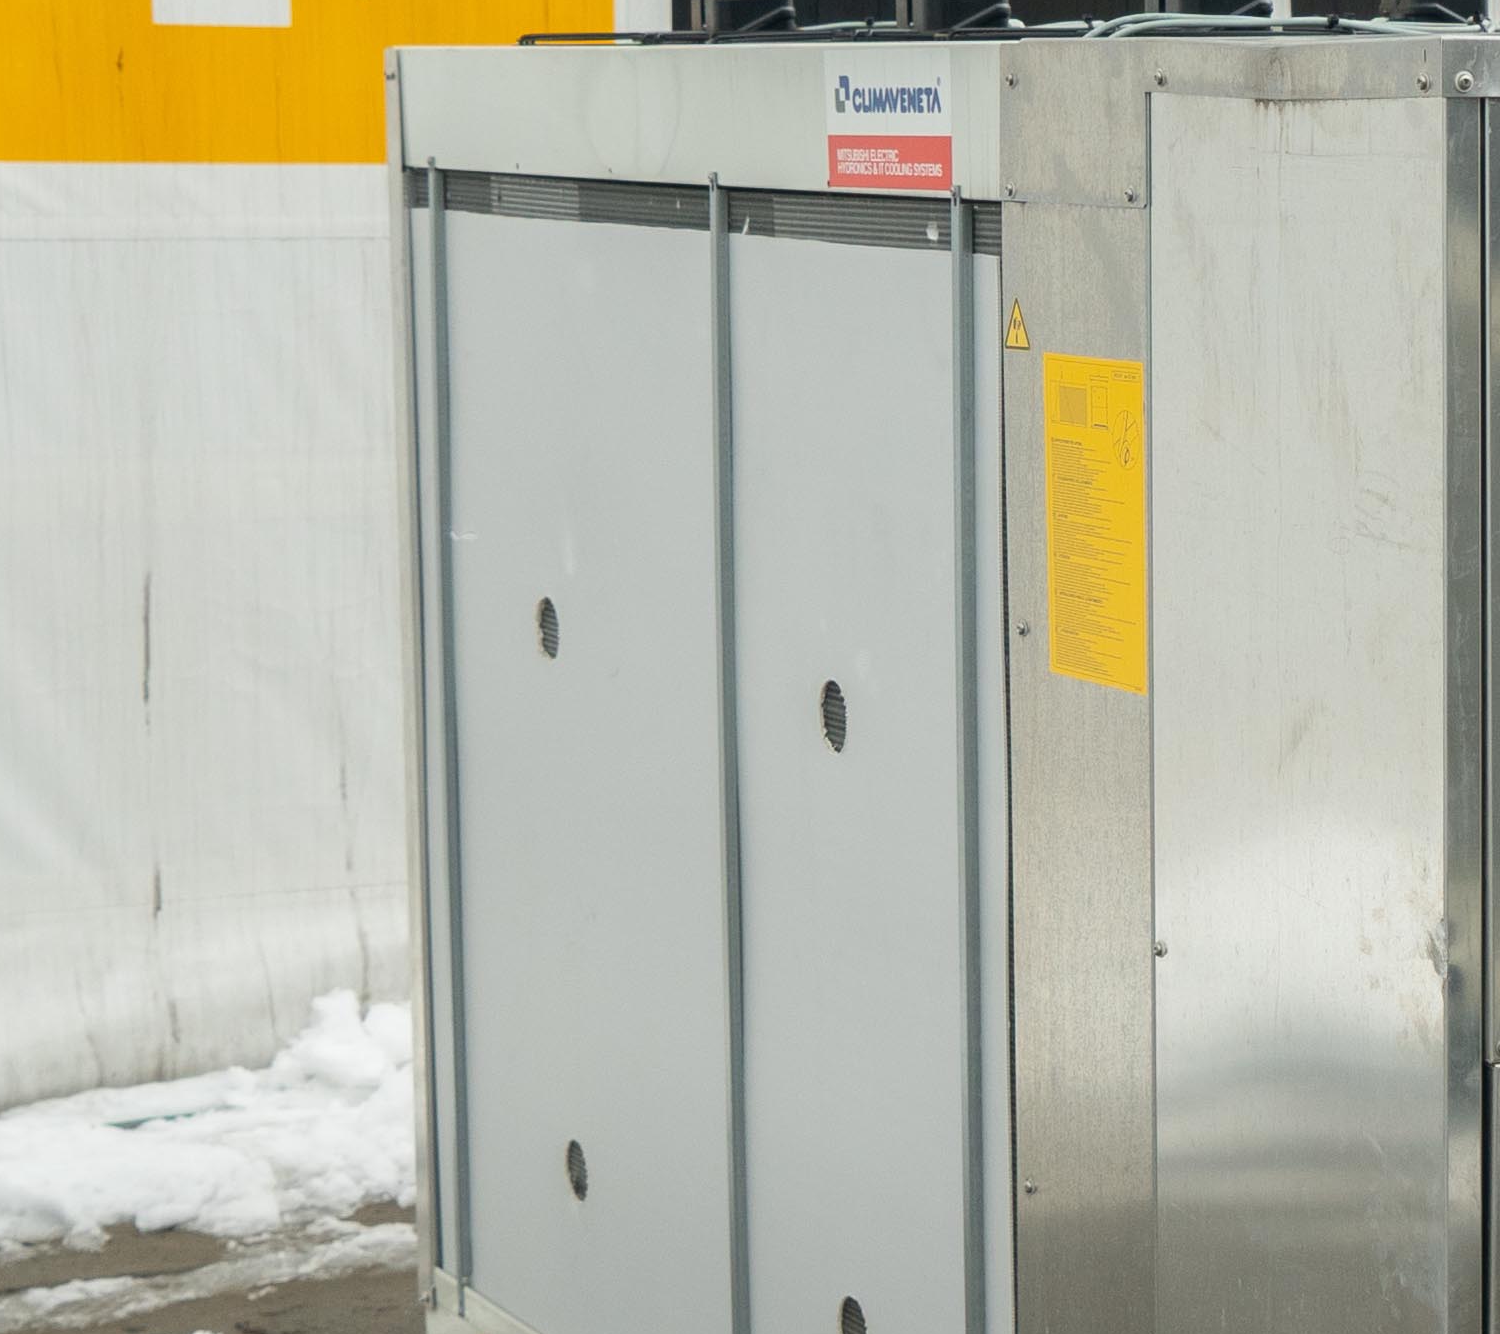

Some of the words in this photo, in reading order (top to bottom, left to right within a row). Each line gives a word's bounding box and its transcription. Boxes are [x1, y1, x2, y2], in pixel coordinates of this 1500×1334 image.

[852, 87, 942, 113] CLIMAVENETA
[870, 148, 900, 162] ELECTRIC
[913, 163, 943, 177] SYSTEMS
